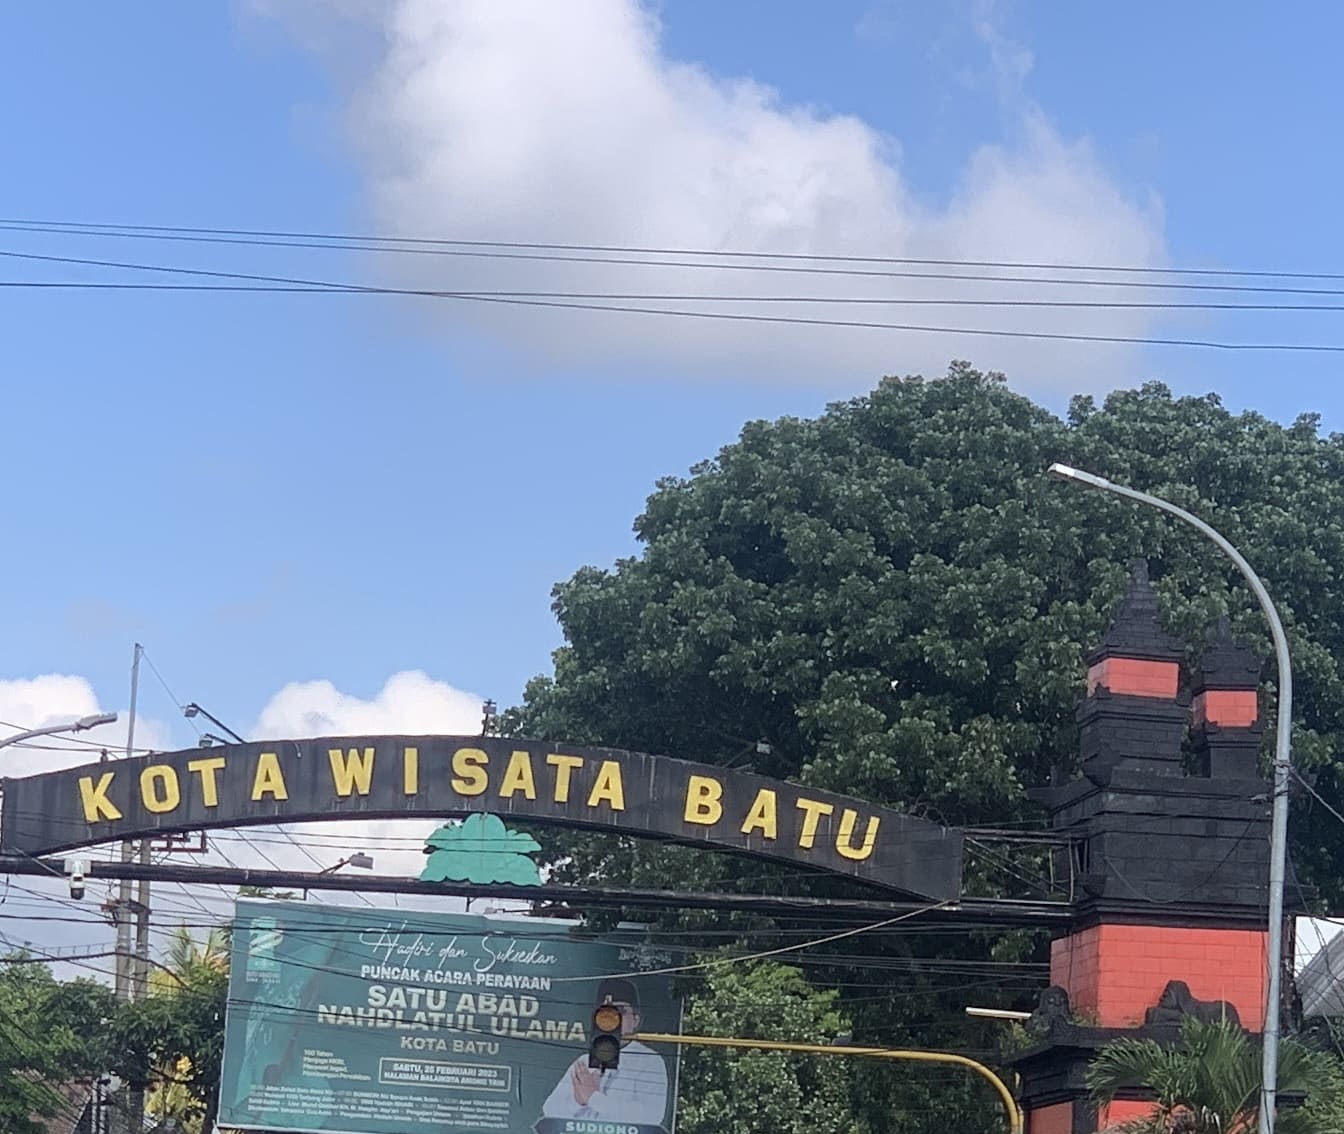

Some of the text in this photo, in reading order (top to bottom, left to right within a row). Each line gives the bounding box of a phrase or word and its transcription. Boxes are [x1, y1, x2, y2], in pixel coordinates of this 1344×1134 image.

[78, 747, 881, 861] KOTA WISATA BATU
[359, 920, 434, 968] Hadiri
[438, 936, 467, 969] dan
[361, 965, 552, 991] PUNCAK ACARA PERAYAAN
[367, 985, 540, 1017] SATU ABAD
[317, 1004, 586, 1042] NAHDLATUL ULAMA
[401, 1036, 500, 1055] KOTA BATU
[393, 1064, 423, 1073] SABTU,
[436, 1066, 476, 1076] FEBRUARI
